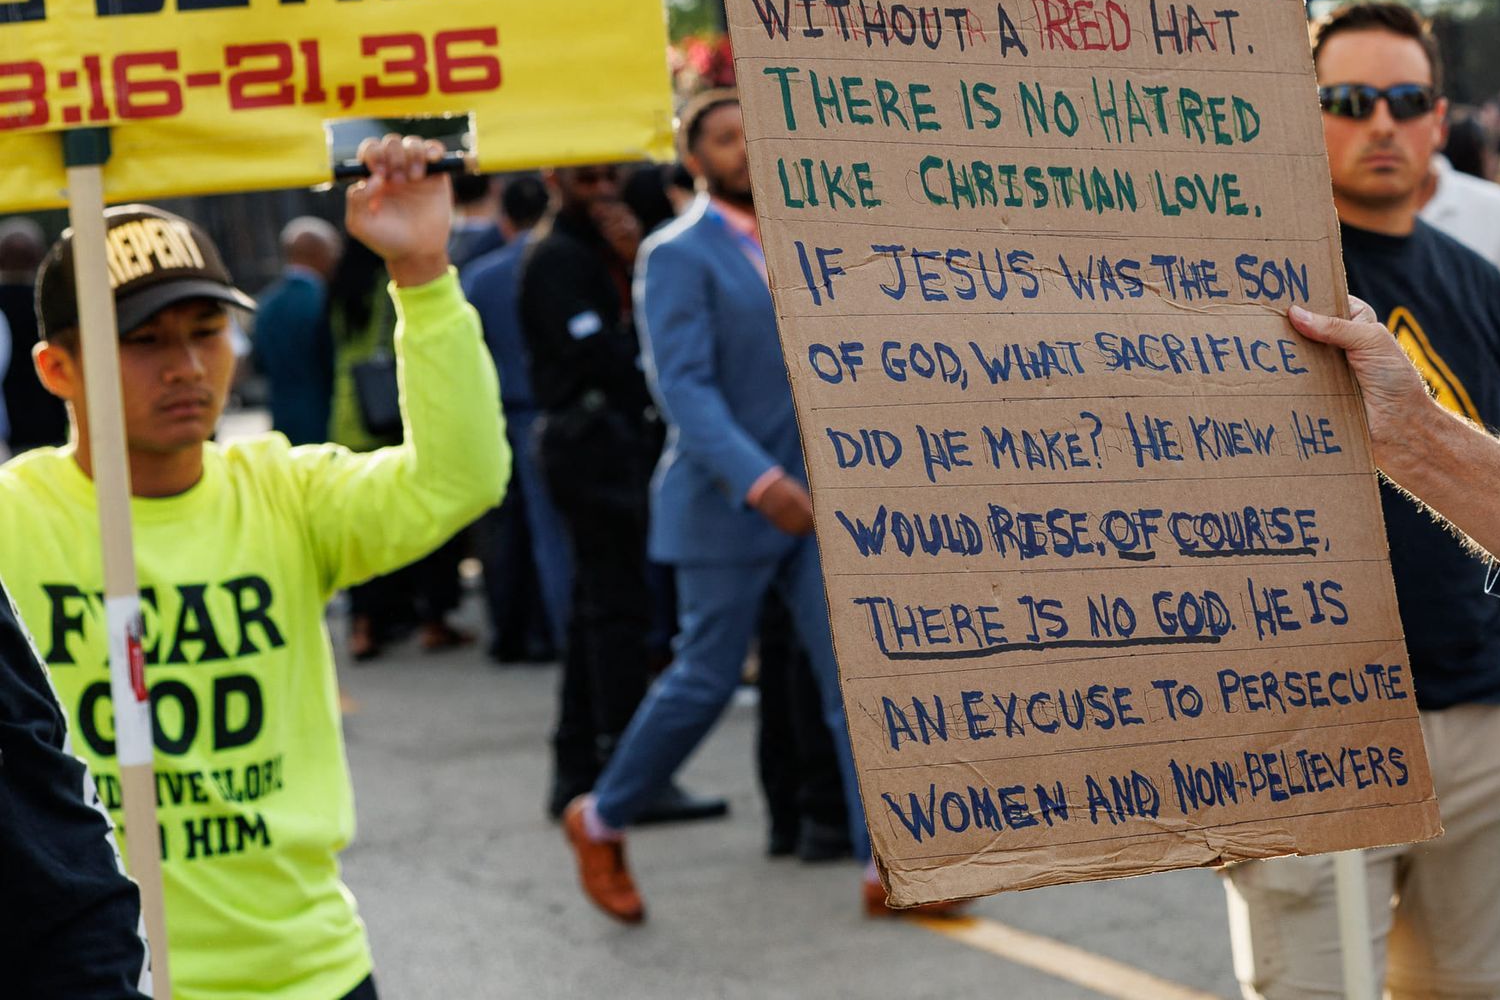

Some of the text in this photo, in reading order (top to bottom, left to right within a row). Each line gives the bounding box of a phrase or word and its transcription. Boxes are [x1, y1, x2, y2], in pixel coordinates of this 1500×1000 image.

[998, 2, 1028, 58] A
[762, 66, 1260, 146] THERE IS NO HATRED
[777, 158, 881, 209] LIKE
[920, 155, 1136, 211] CHRISTIAN
[794, 240, 1309, 306] IF JESUS WAS THE SON
[808, 331, 1308, 391] OF GOD, WHAT SACRIFICE
[826, 410, 1342, 483] DID HE MAKE? HE KNEW HE
[834, 505, 982, 557] WOULD
[1099, 508, 1163, 552] OF
[853, 577, 1348, 654] THERE IS NO GOD. HE IS
[881, 663, 1407, 752] AN EXCUSE TO PERSECUTE
[155, 771, 208, 807] IVE
[881, 746, 1409, 844] WOMEN AND NON-BELIEVERS
[184, 813, 271, 860] HIM
